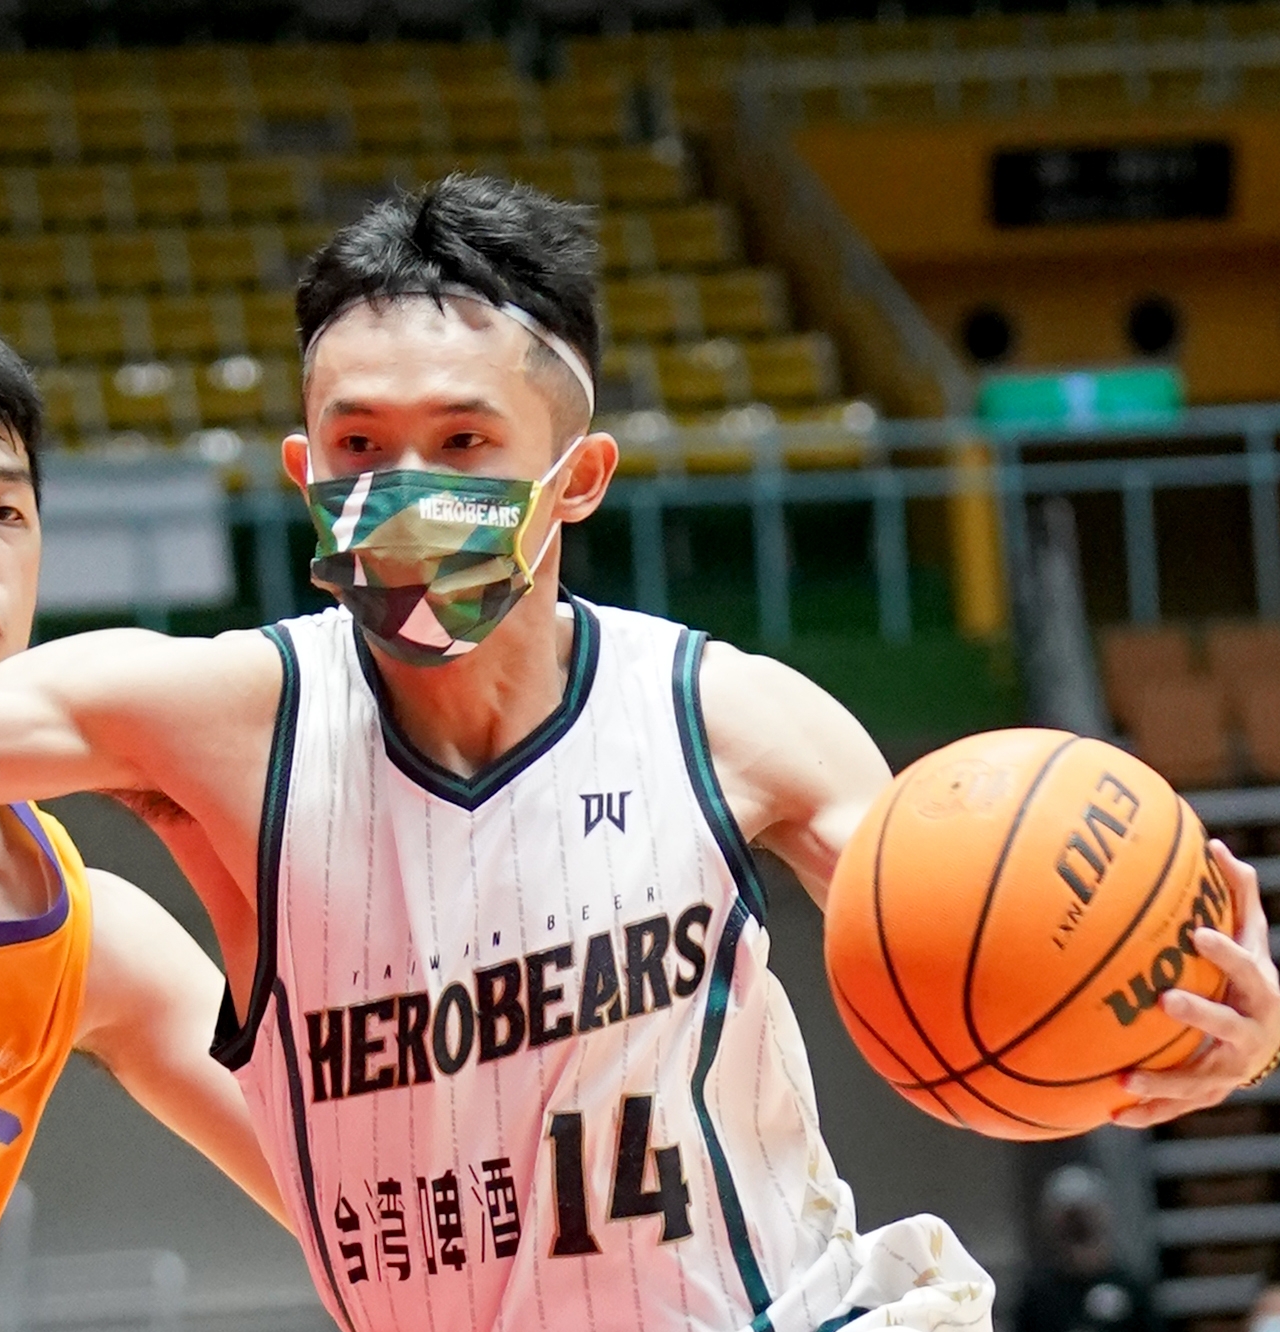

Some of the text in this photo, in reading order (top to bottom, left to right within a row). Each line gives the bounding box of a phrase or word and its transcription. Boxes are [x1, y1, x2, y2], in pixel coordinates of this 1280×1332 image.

[419, 497, 520, 528] HEROBEARS
[546, 886, 655, 931] BEER
[305, 903, 713, 1103] HEROBEARS
[545, 1092, 694, 1259] 14
